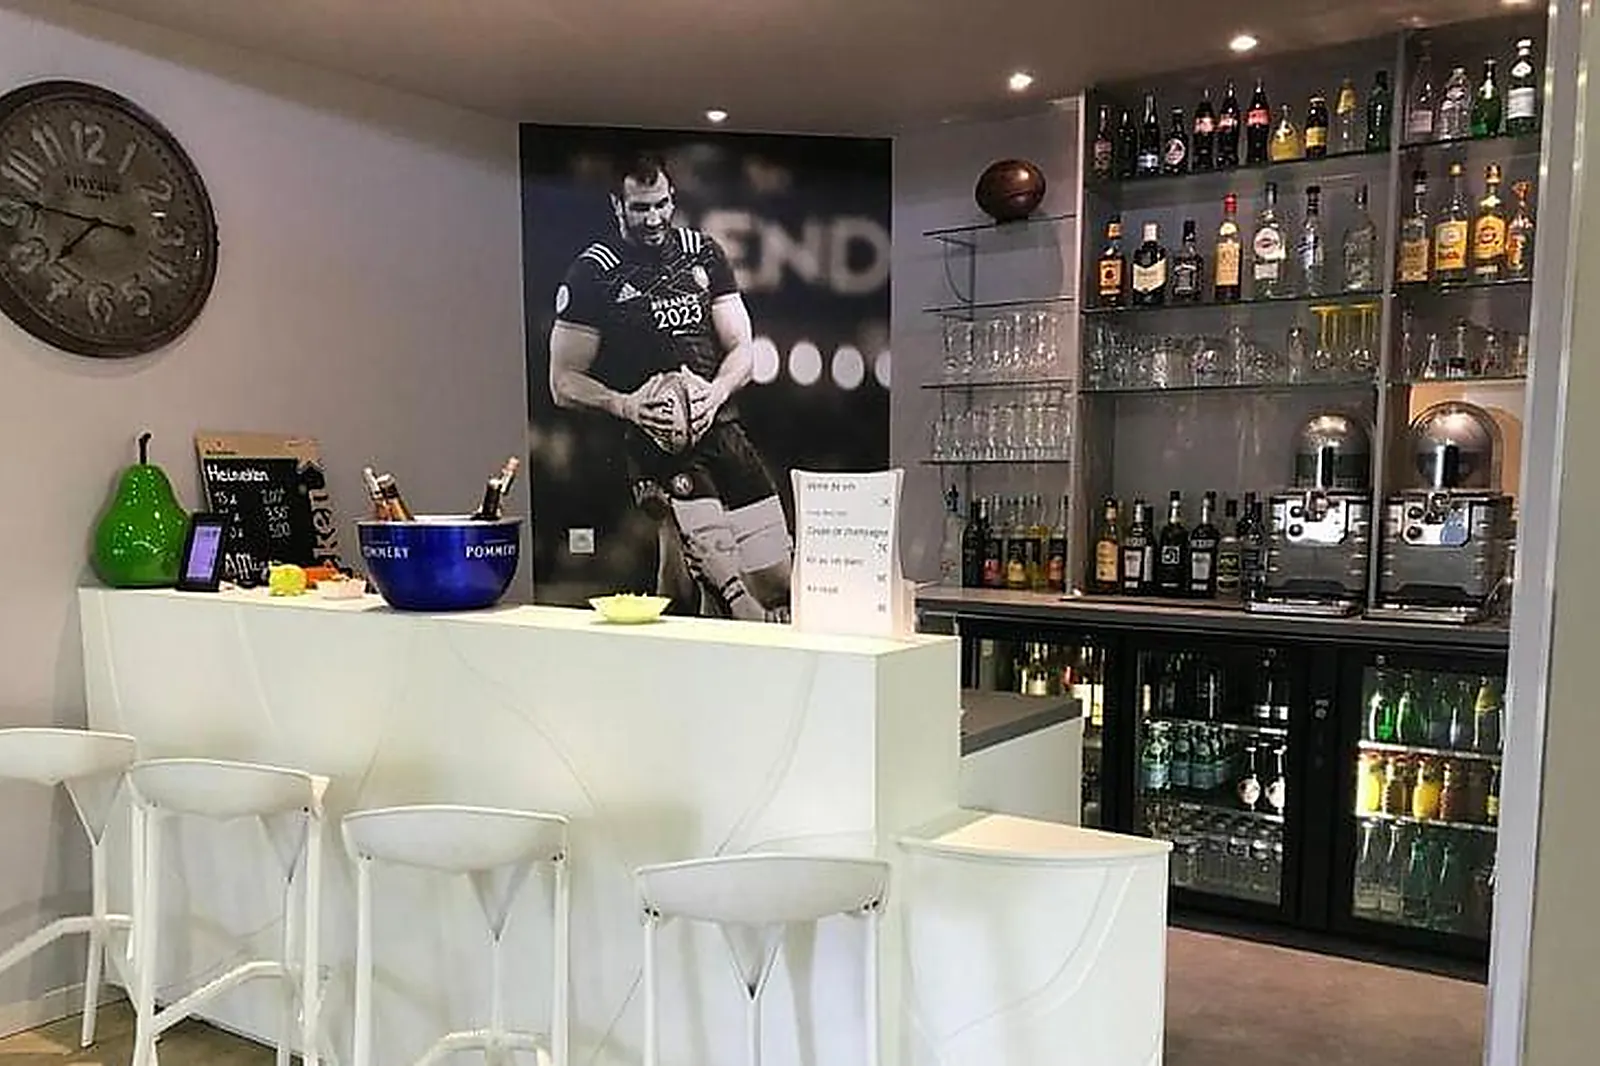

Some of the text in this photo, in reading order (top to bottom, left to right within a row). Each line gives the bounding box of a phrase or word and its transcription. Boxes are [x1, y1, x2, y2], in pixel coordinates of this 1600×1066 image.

[70, 119, 106, 166] 12
[117, 142, 137, 175] 1
[133, 179, 173, 202] 2
[151, 222, 187, 247] 3
[87, 281, 117, 326] 6
[121, 274, 152, 318] 5
[654, 304, 702, 329] 2023
